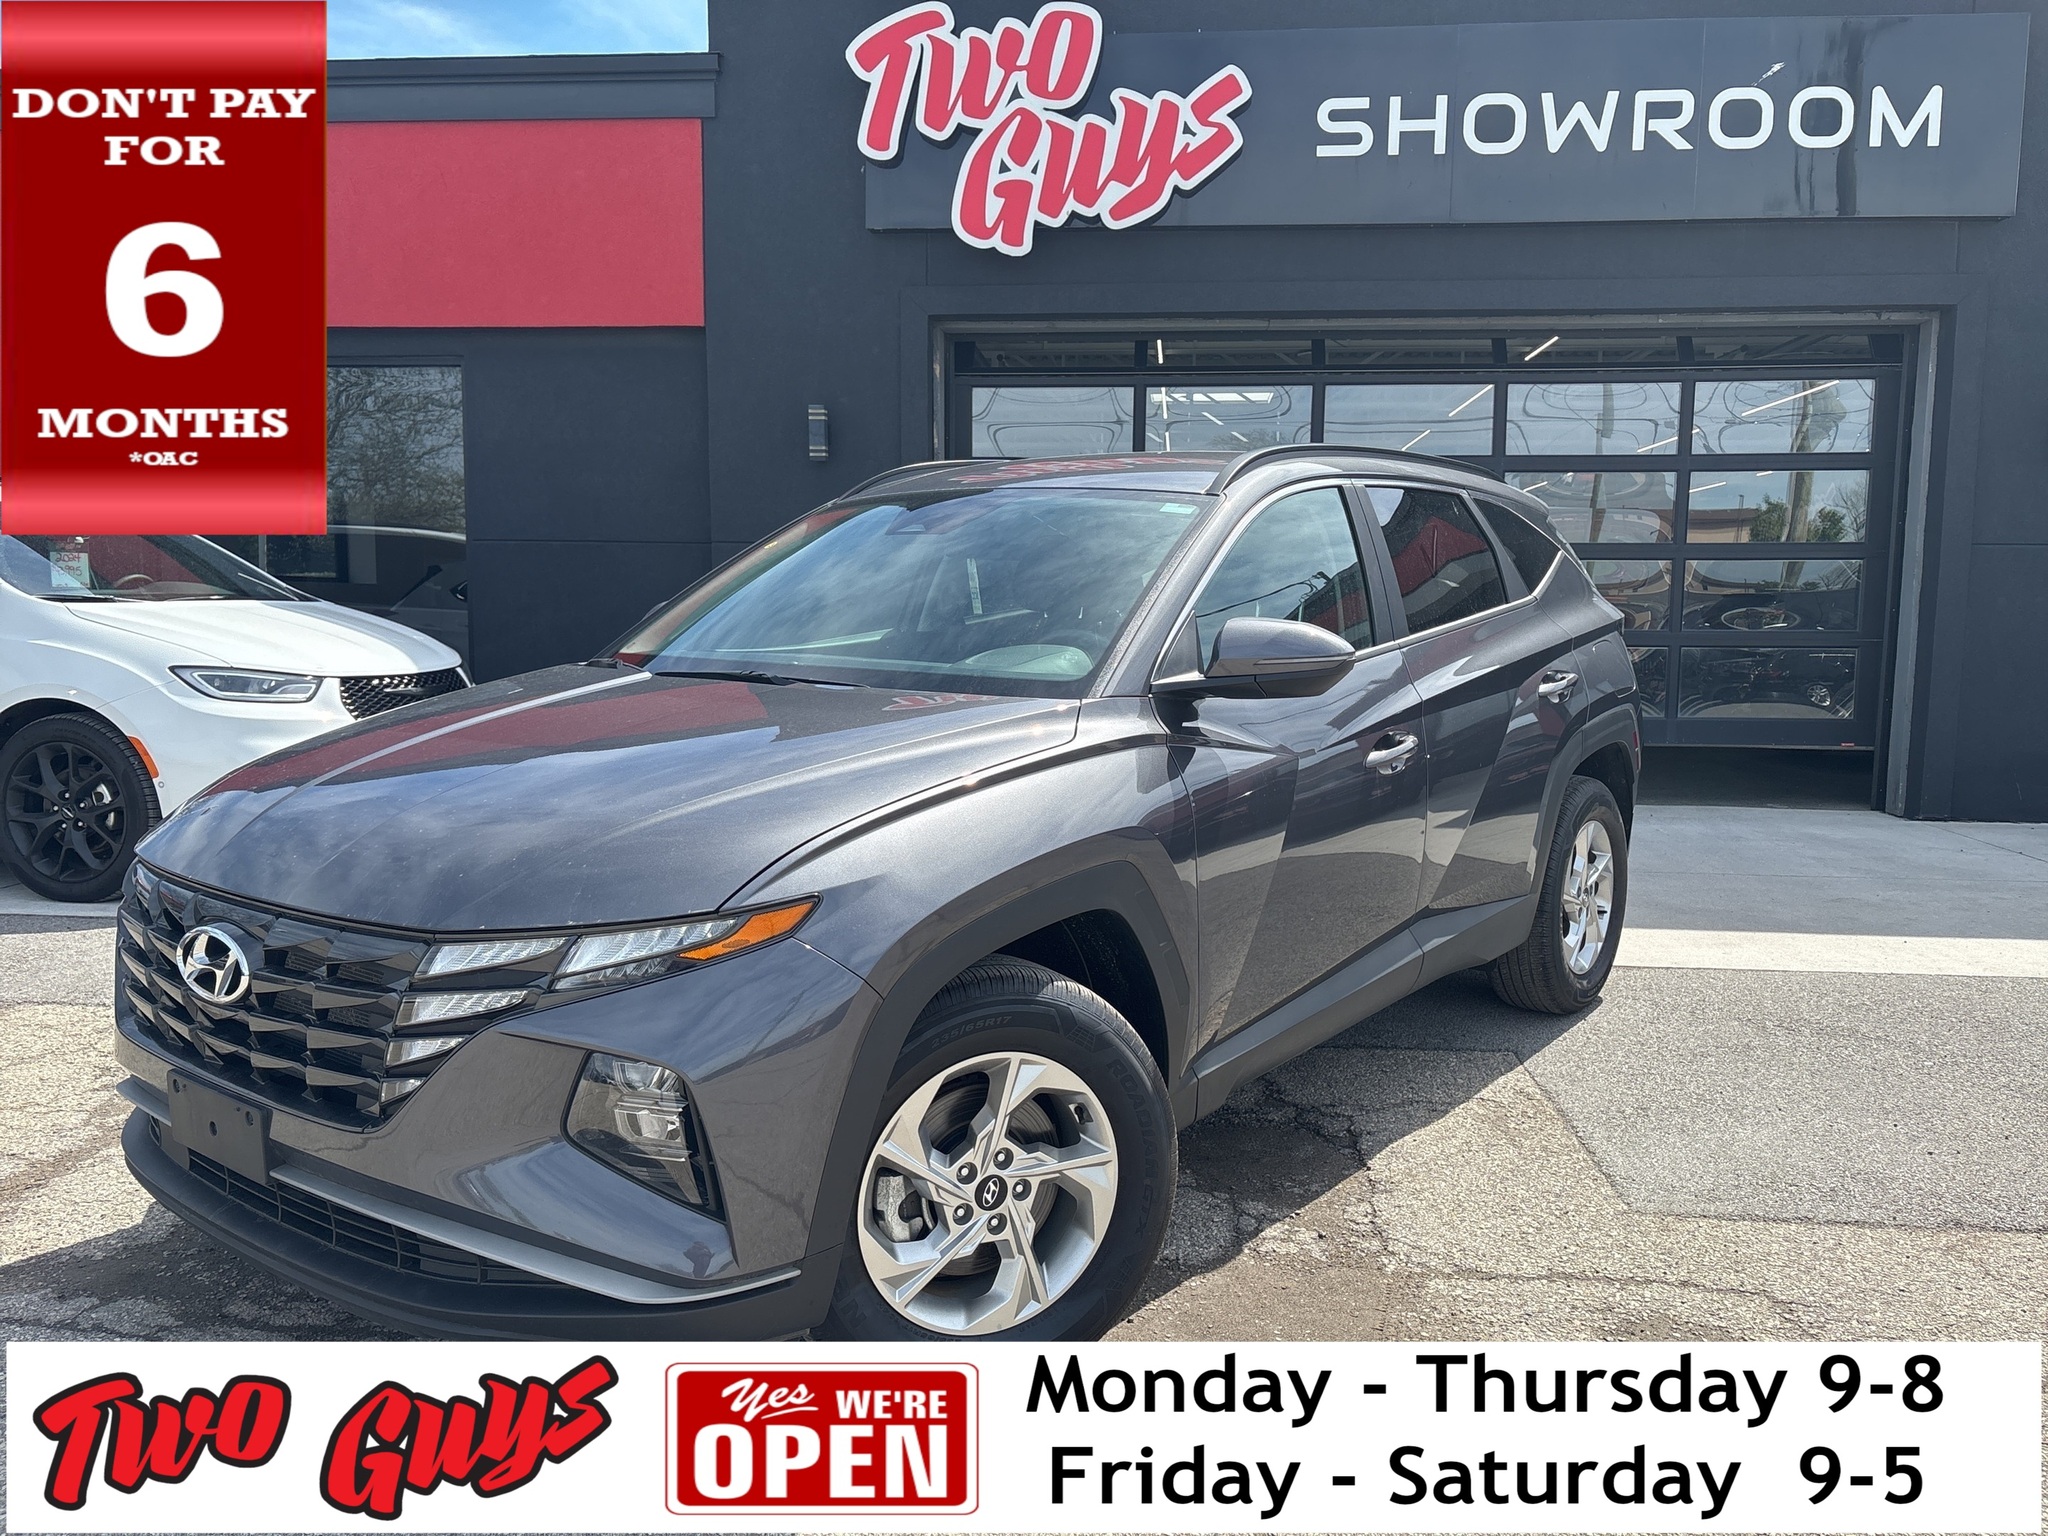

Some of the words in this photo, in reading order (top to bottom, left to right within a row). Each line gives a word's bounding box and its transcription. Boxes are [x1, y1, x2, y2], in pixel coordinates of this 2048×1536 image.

[847, 3, 1101, 159] Two
[1316, 84, 1943, 157] SHOWROOM
[953, 66, 1251, 254] Guys
[931, 1015, 1012, 1049] 235/65R17
